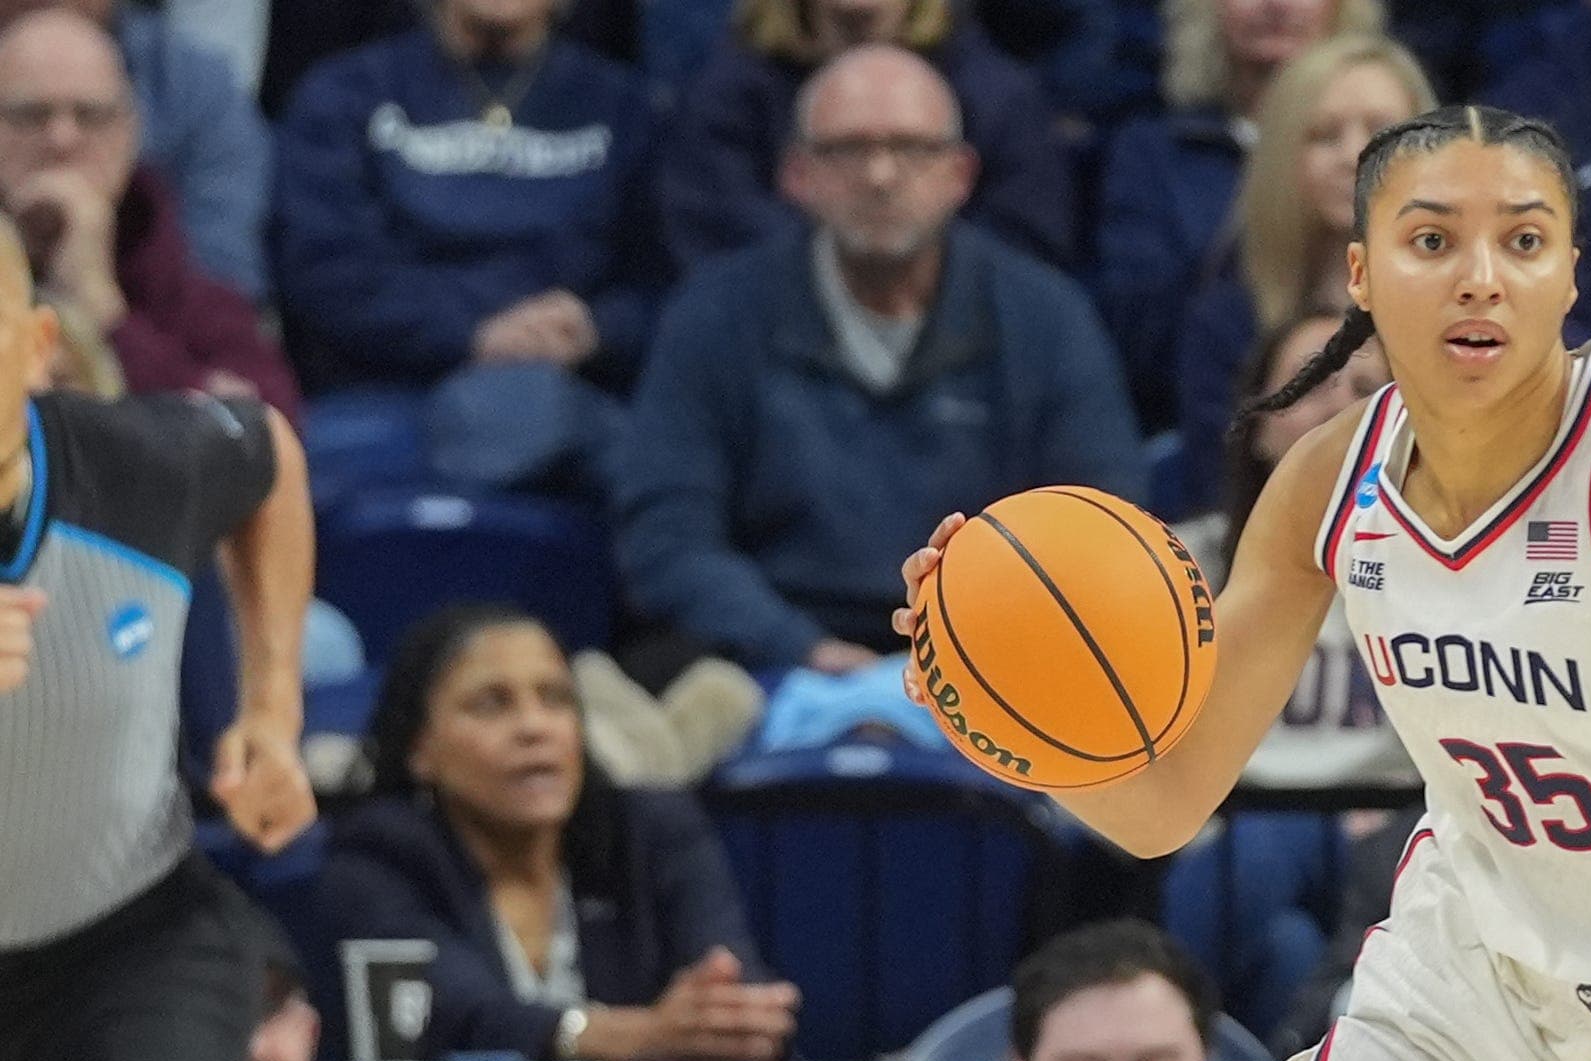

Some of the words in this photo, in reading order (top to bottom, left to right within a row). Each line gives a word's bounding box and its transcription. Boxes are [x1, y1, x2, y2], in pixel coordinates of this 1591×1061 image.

[1359, 561, 1385, 576] THE
[1533, 571, 1574, 585] BIG
[1527, 585, 1585, 598] EAST
[1363, 632, 1588, 713] UCONN
[912, 599, 1034, 777] Wilson
